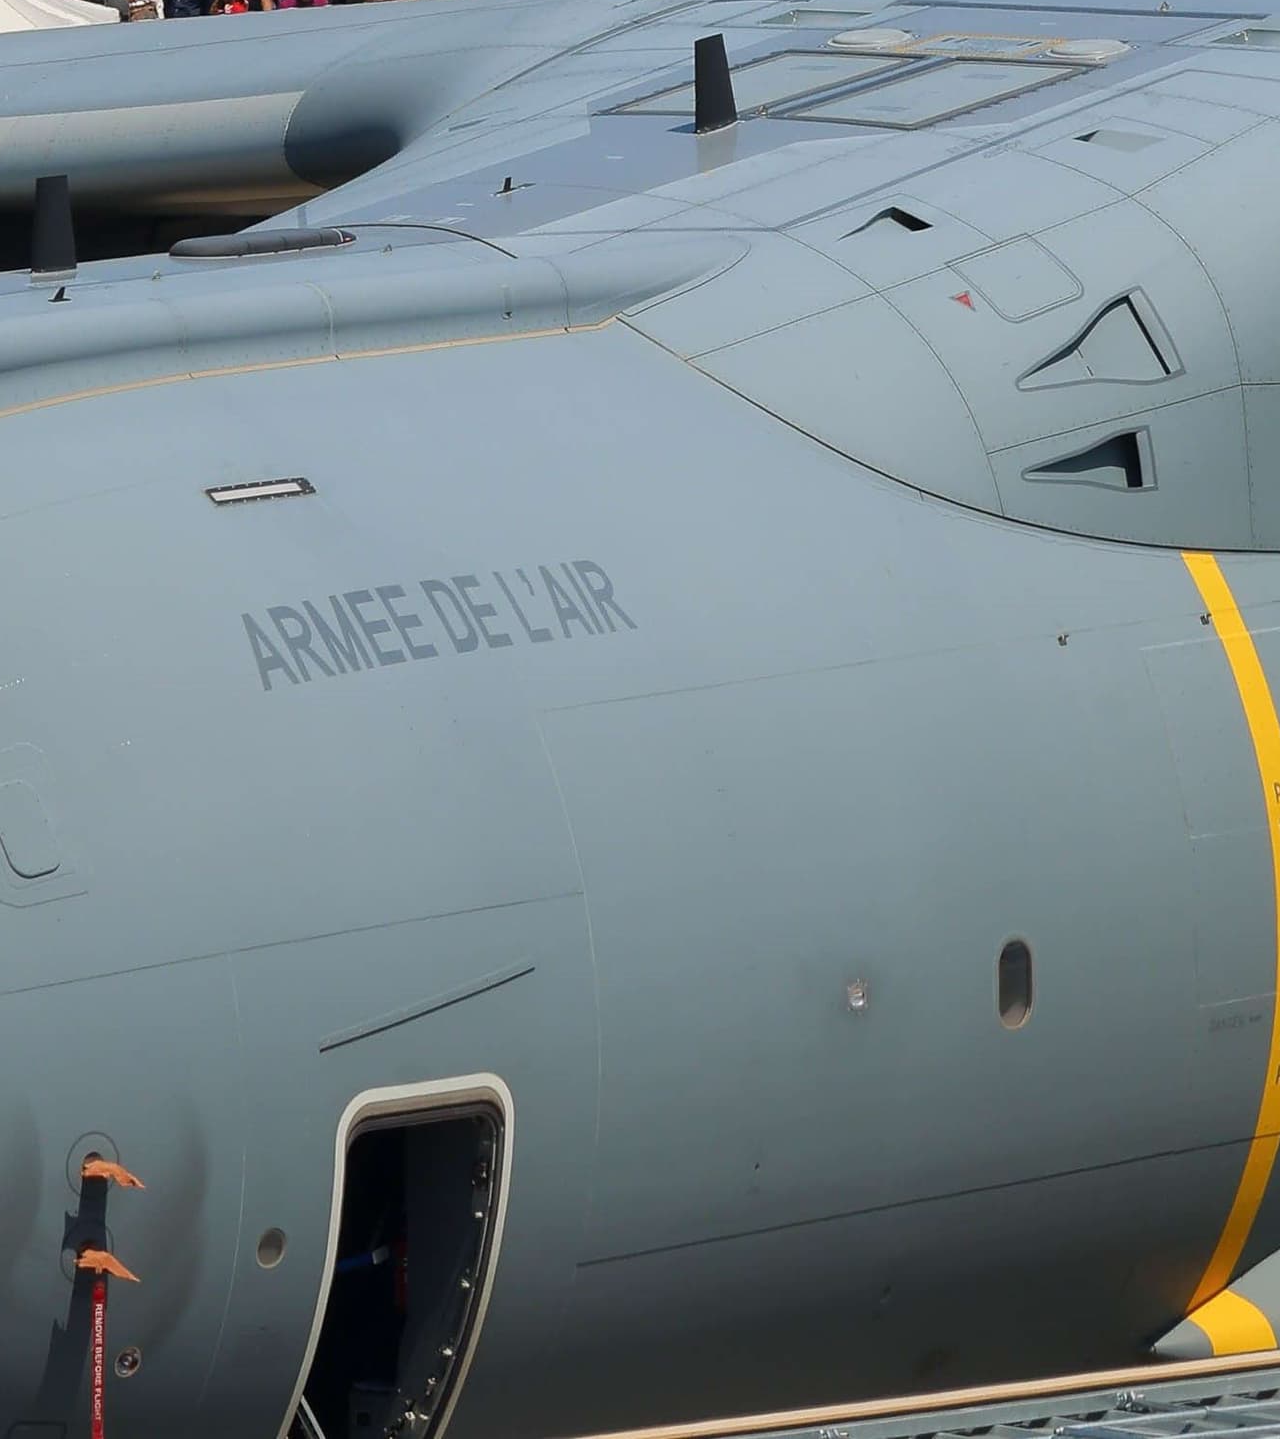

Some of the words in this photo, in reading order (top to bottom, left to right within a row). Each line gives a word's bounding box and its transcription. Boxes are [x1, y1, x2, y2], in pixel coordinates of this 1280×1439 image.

[241, 584, 439, 691] ARMEE
[419, 574, 514, 654] DE
[492, 559, 639, 644] L'AIR
[94, 1303, 104, 1344] REMOVE
[94, 1346, 103, 1386] BEFORE
[93, 1387, 102, 1420] FLIGHT
